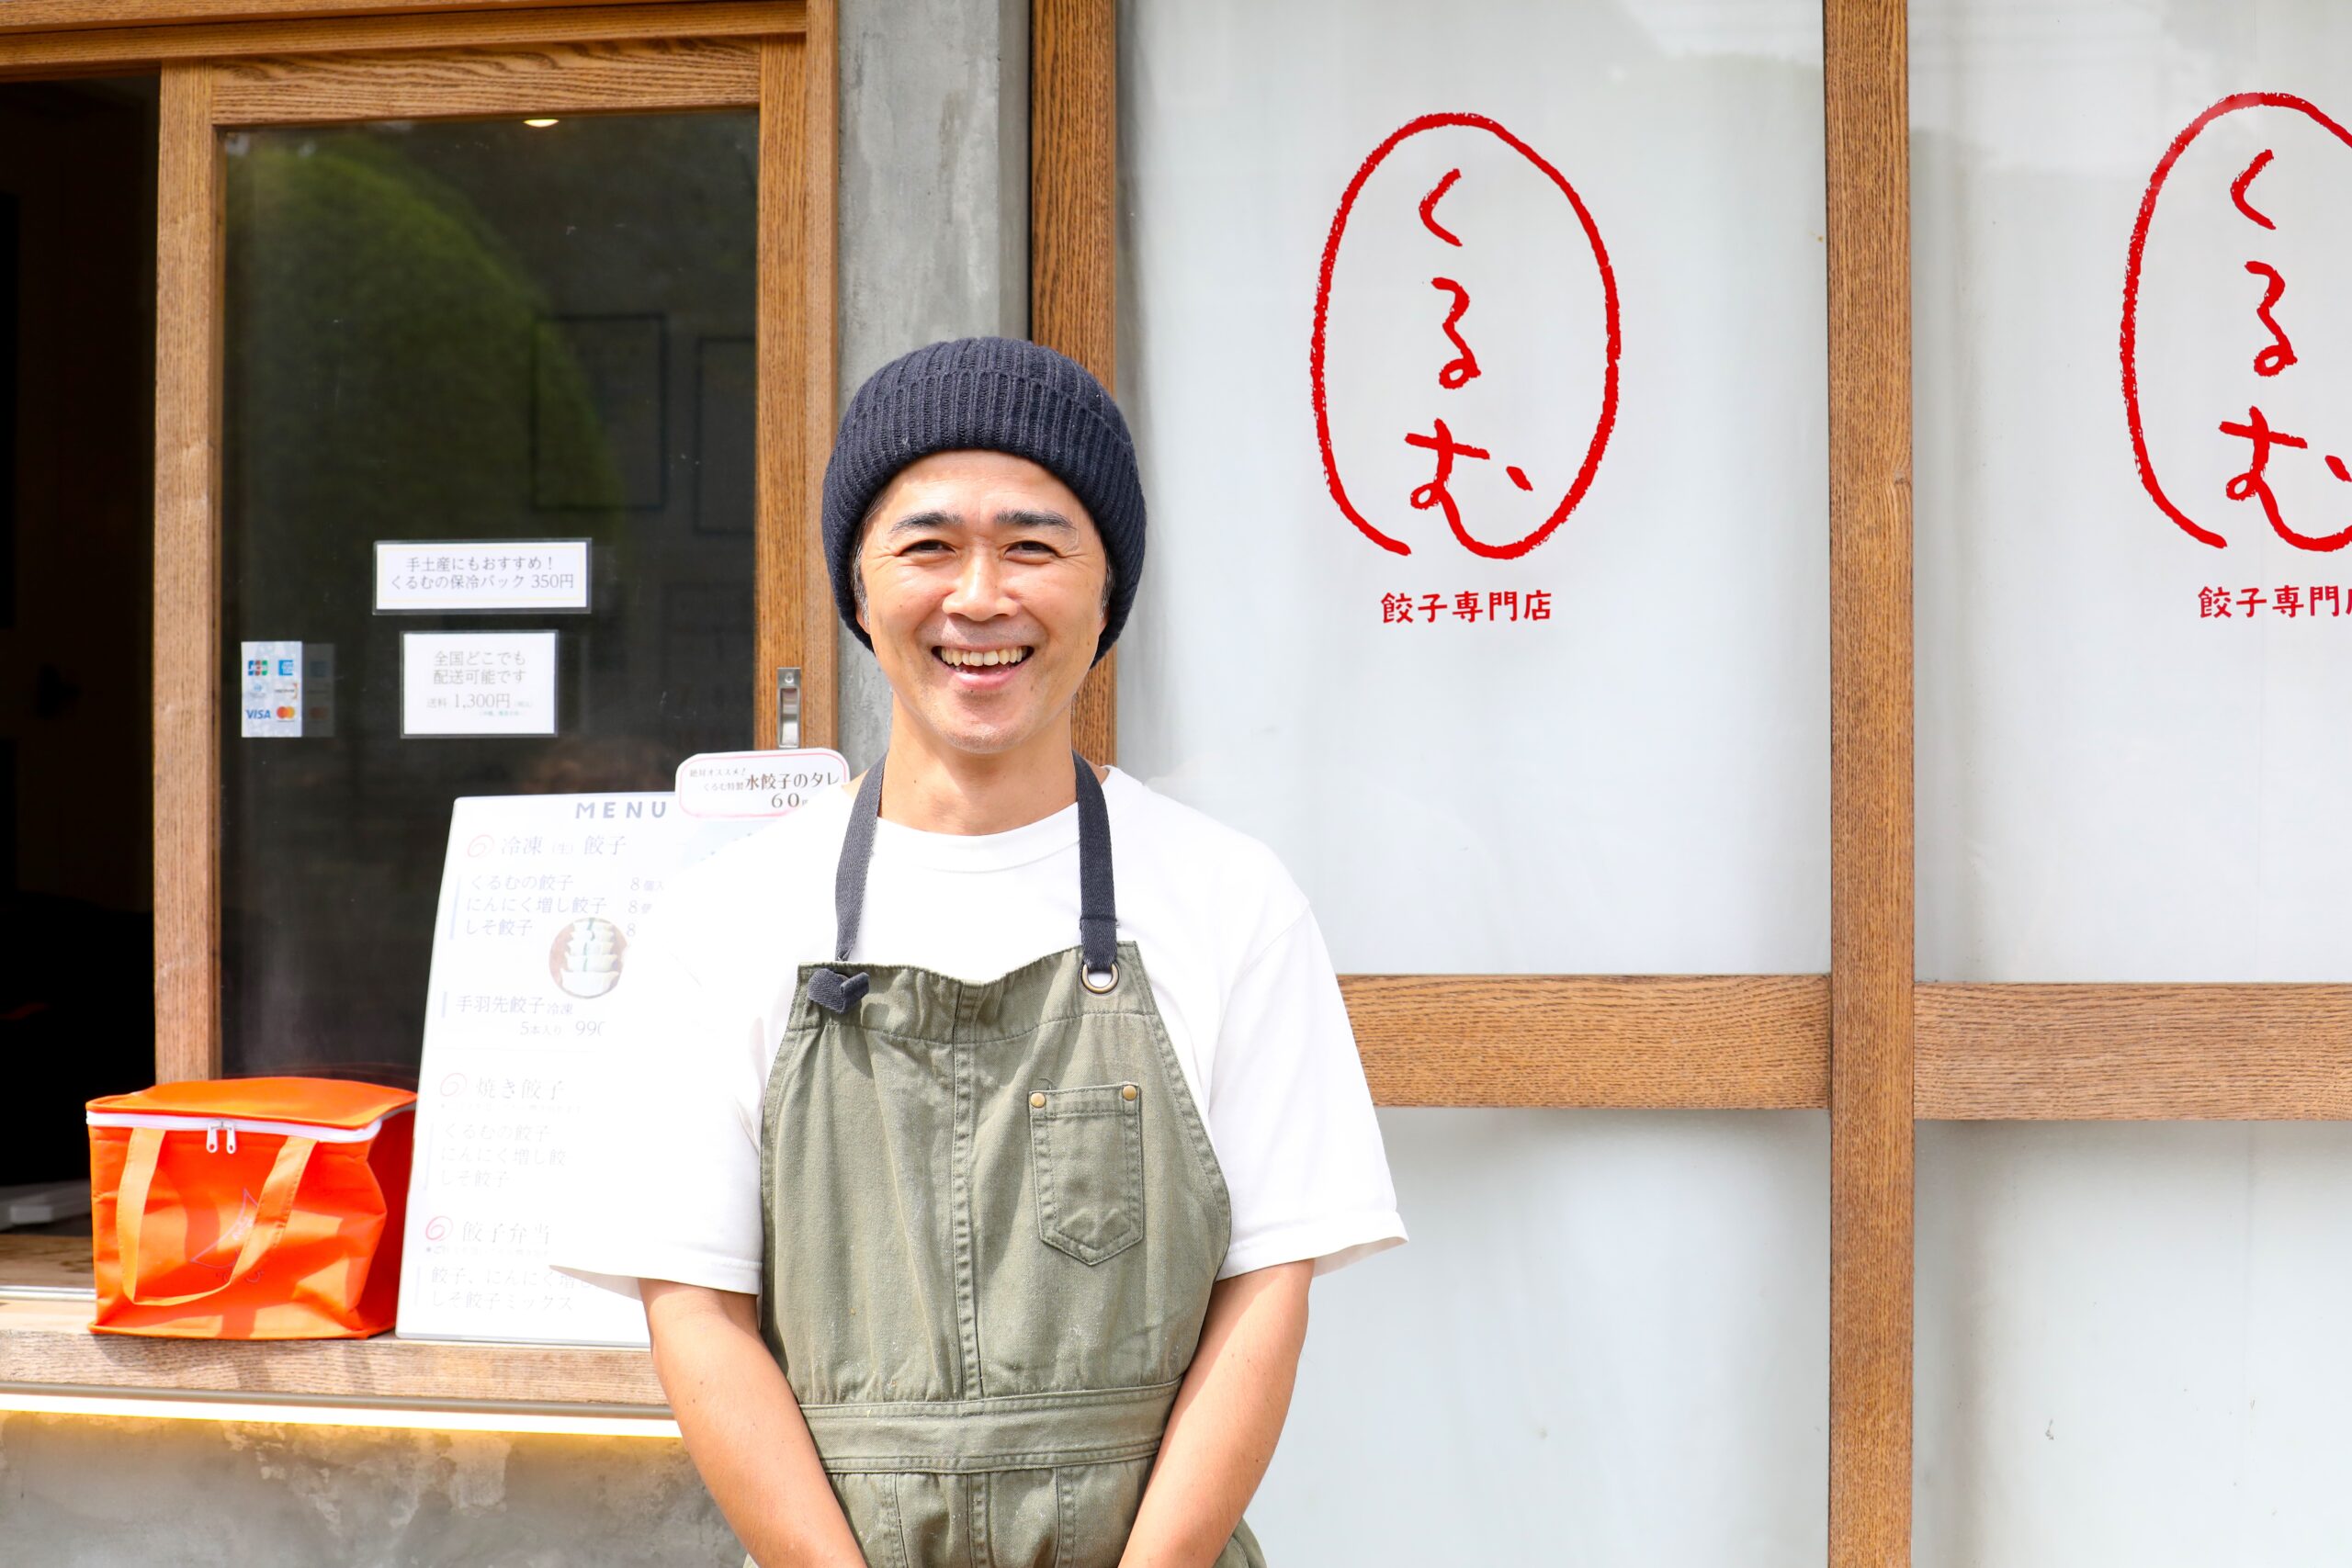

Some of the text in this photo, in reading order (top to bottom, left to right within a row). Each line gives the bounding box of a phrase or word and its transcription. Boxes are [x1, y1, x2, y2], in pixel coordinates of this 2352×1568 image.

[2218, 148, 2352, 552] くるむ
[1404, 167, 1534, 559] くるむ
[531, 573, 573, 589] 350円
[1380, 589, 1552, 624] 餃子専門店
[435, 650, 526, 667] 全国どこでも
[434, 669, 527, 685] 配送可能です
[246, 709, 271, 719] VISA
[745, 772, 840, 791] 水餃子のタレ
[575, 801, 667, 819] MENU
[466, 919, 533, 937] しそ餃子
